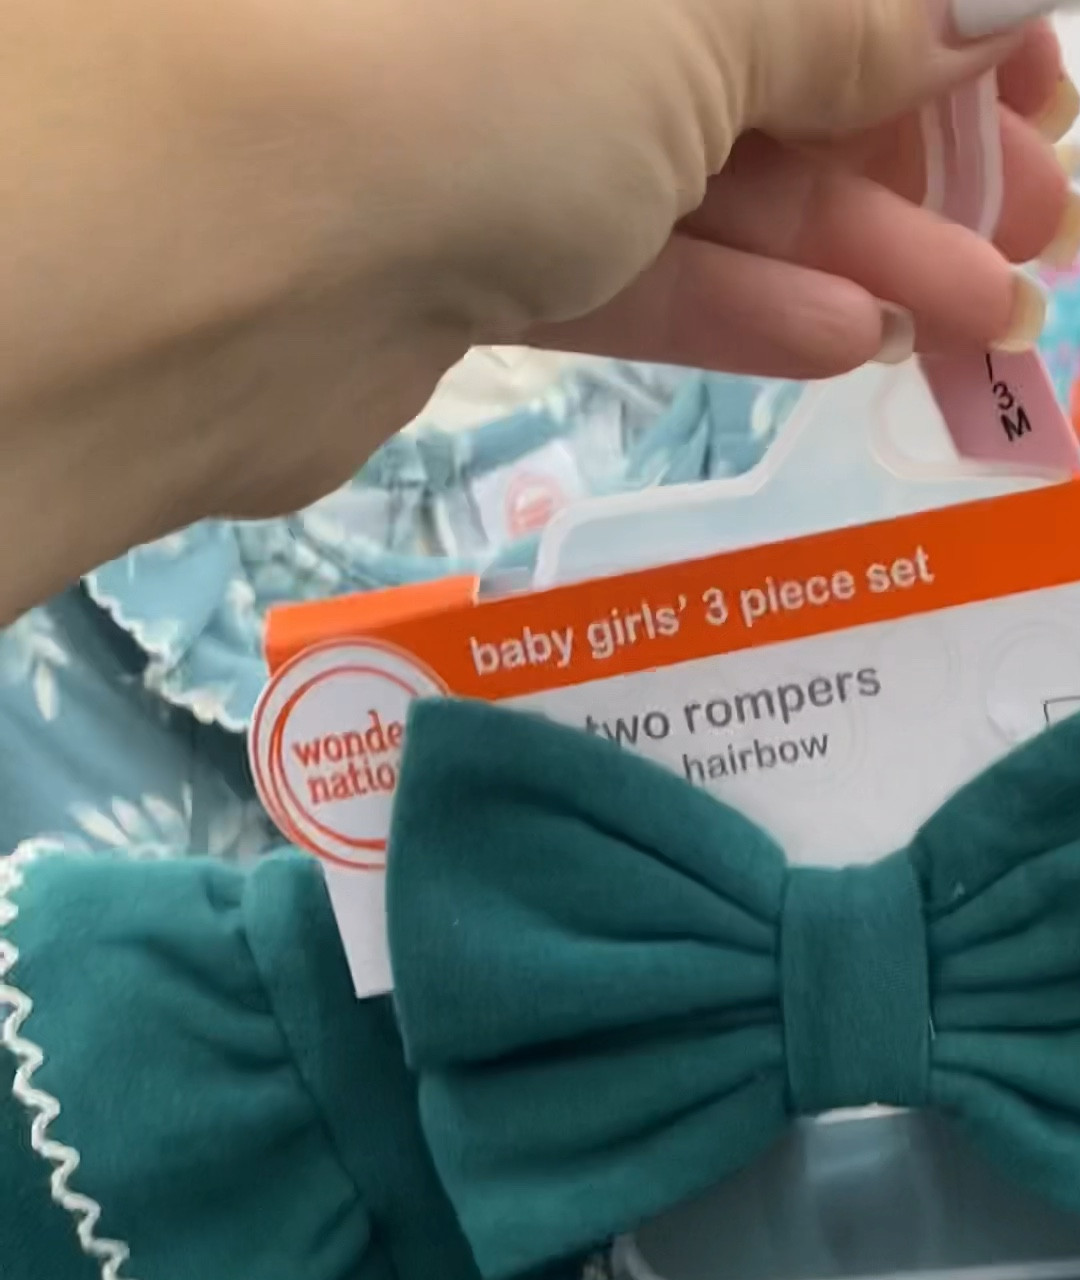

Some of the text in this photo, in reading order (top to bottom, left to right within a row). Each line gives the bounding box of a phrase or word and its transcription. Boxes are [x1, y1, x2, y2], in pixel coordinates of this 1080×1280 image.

[470, 544, 936, 677] baby girls' 3 piece set
[586, 665, 882, 748] two rompers
[291, 708, 404, 768] wonde
[682, 732, 830, 784] hairbow
[306, 756, 398, 806] natio
